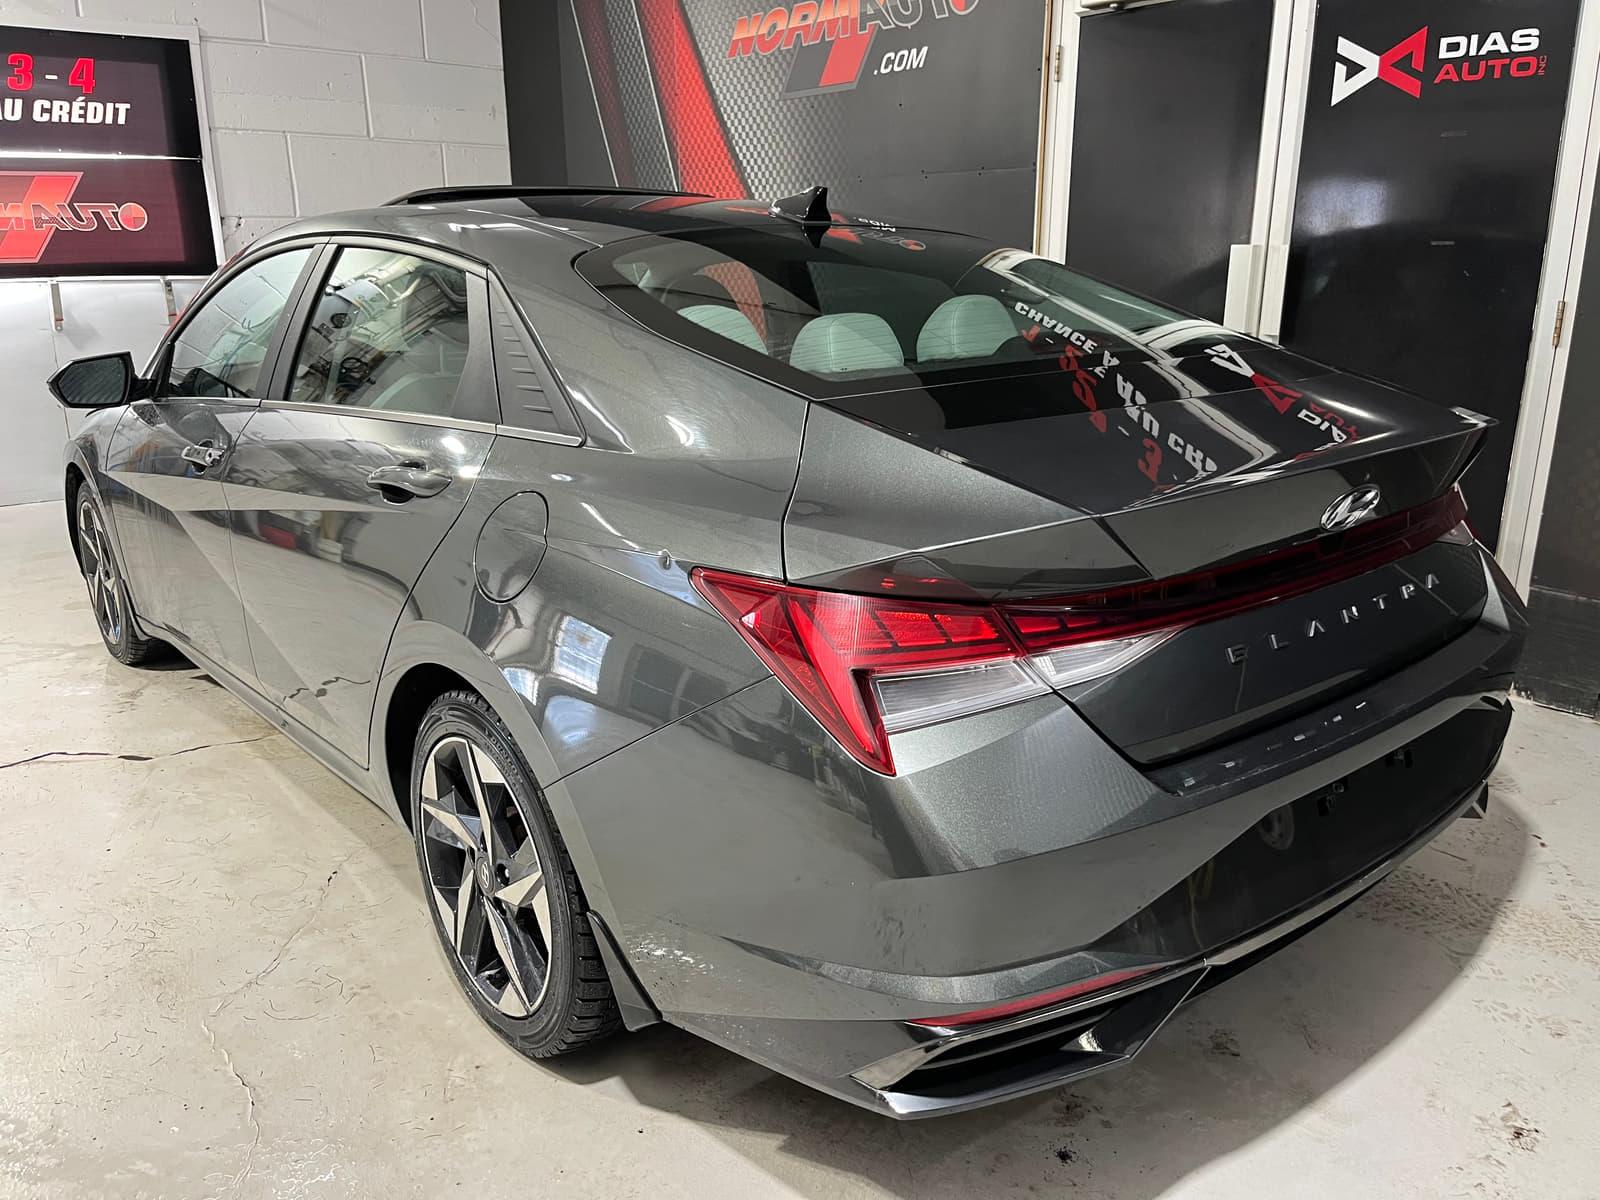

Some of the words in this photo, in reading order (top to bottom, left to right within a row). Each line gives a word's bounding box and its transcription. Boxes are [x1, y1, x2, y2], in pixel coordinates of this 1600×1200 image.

[1439, 28, 1540, 59] DIAS
[7, 53, 34, 91] 3
[68, 57, 96, 94] 4
[873, 46, 928, 76] .COM
[1433, 56, 1537, 84] AUTO
[0, 98, 23, 122] U
[32, 96, 131, 125] CRÉDIT
[1225, 573, 1440, 664] ELANTRA
